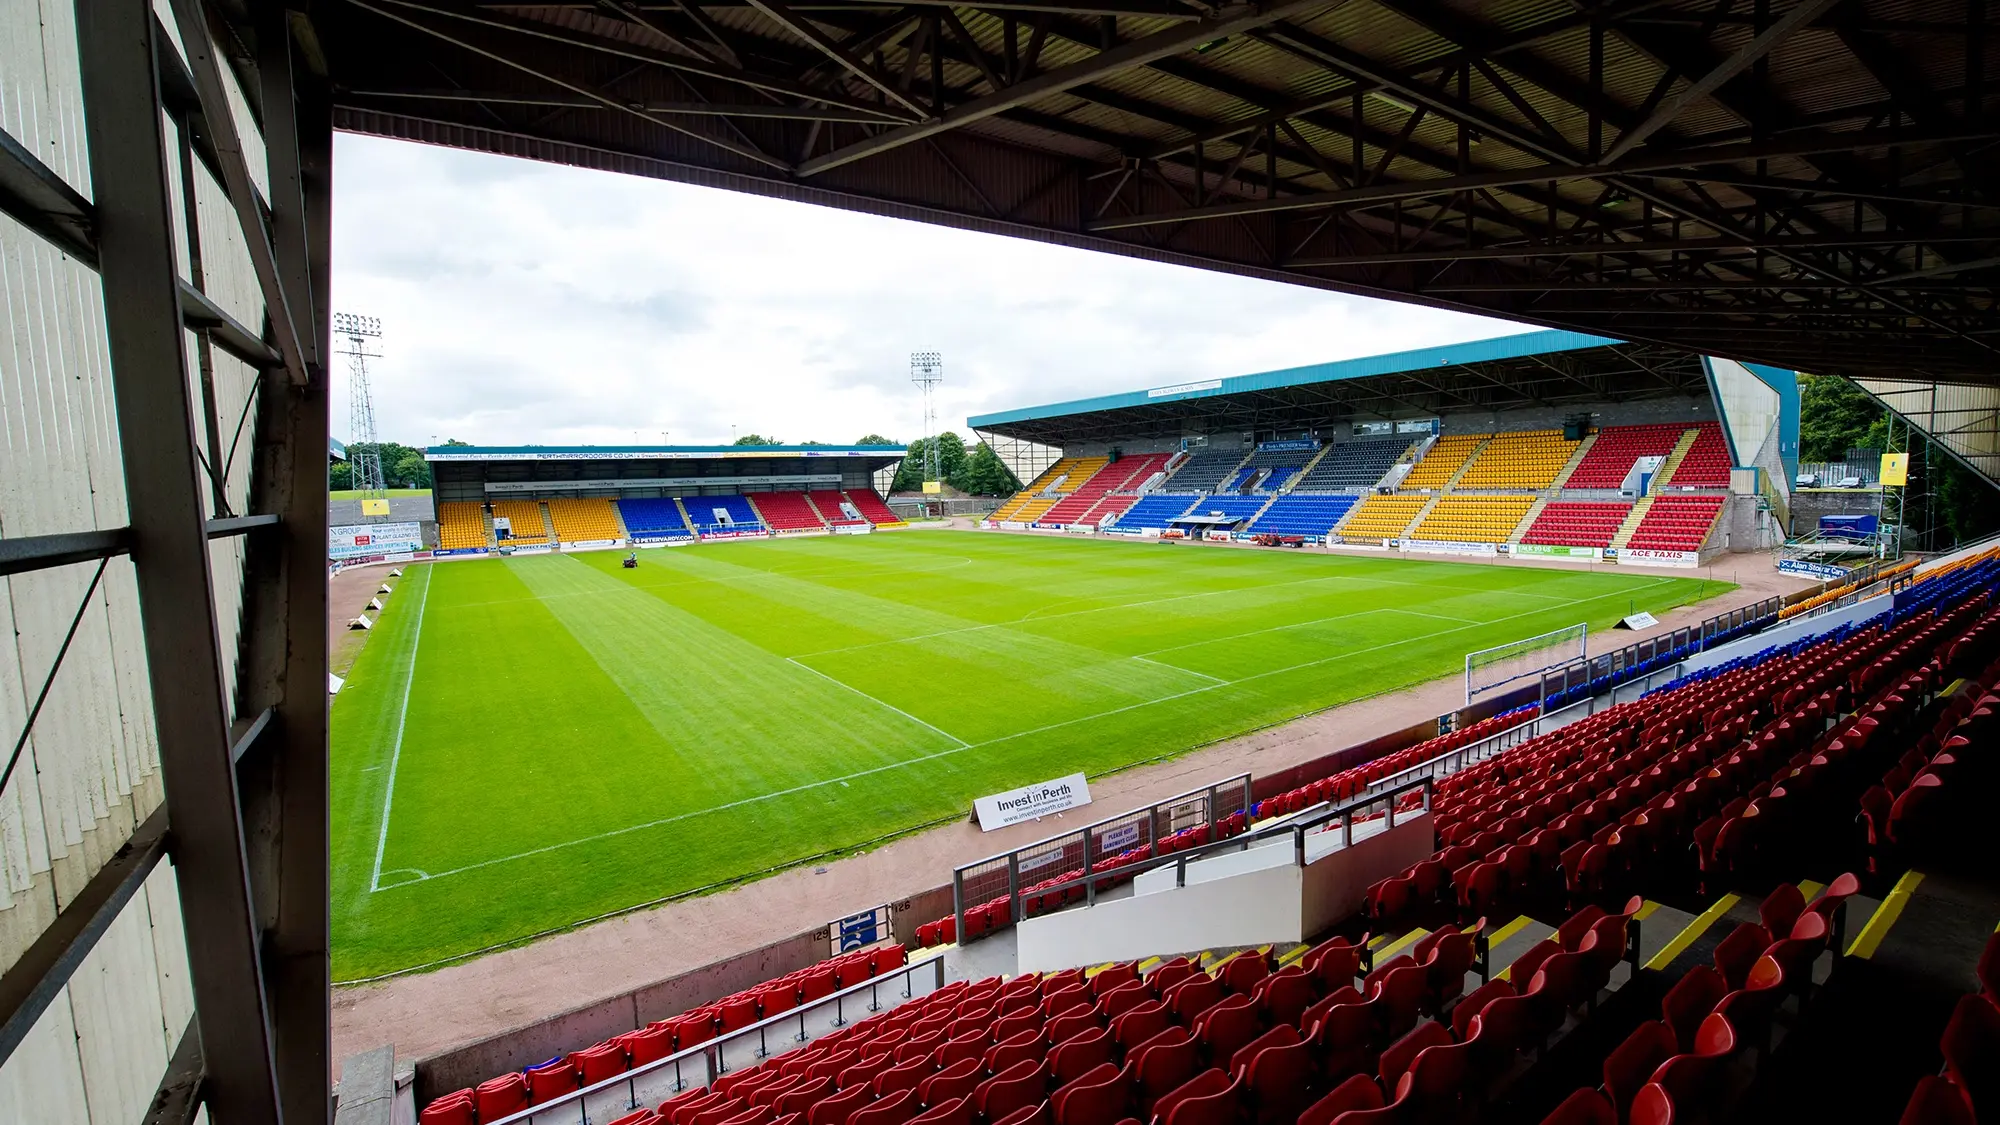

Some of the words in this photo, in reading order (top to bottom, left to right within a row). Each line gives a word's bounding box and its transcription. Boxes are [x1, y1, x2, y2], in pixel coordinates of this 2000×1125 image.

[337, 527, 361, 535] GROUP
[640, 535, 694, 543] PETERVARDY.COM
[1654, 551, 1683, 559] TAXIS
[1791, 562, 1807, 570] Alan
[1831, 567, 1844, 576] Cars
[997, 794, 1032, 811] Invest
[1032, 791, 1042, 802] in
[1042, 784, 1071, 800] Perth
[1003, 800, 1073, 823] www.investinperth.co.uk
[1108, 831, 1123, 840] PLEASE
[1125, 833, 1138, 842] CLEAR
[895, 901, 911, 913] 126
[813, 929, 829, 942] 129
